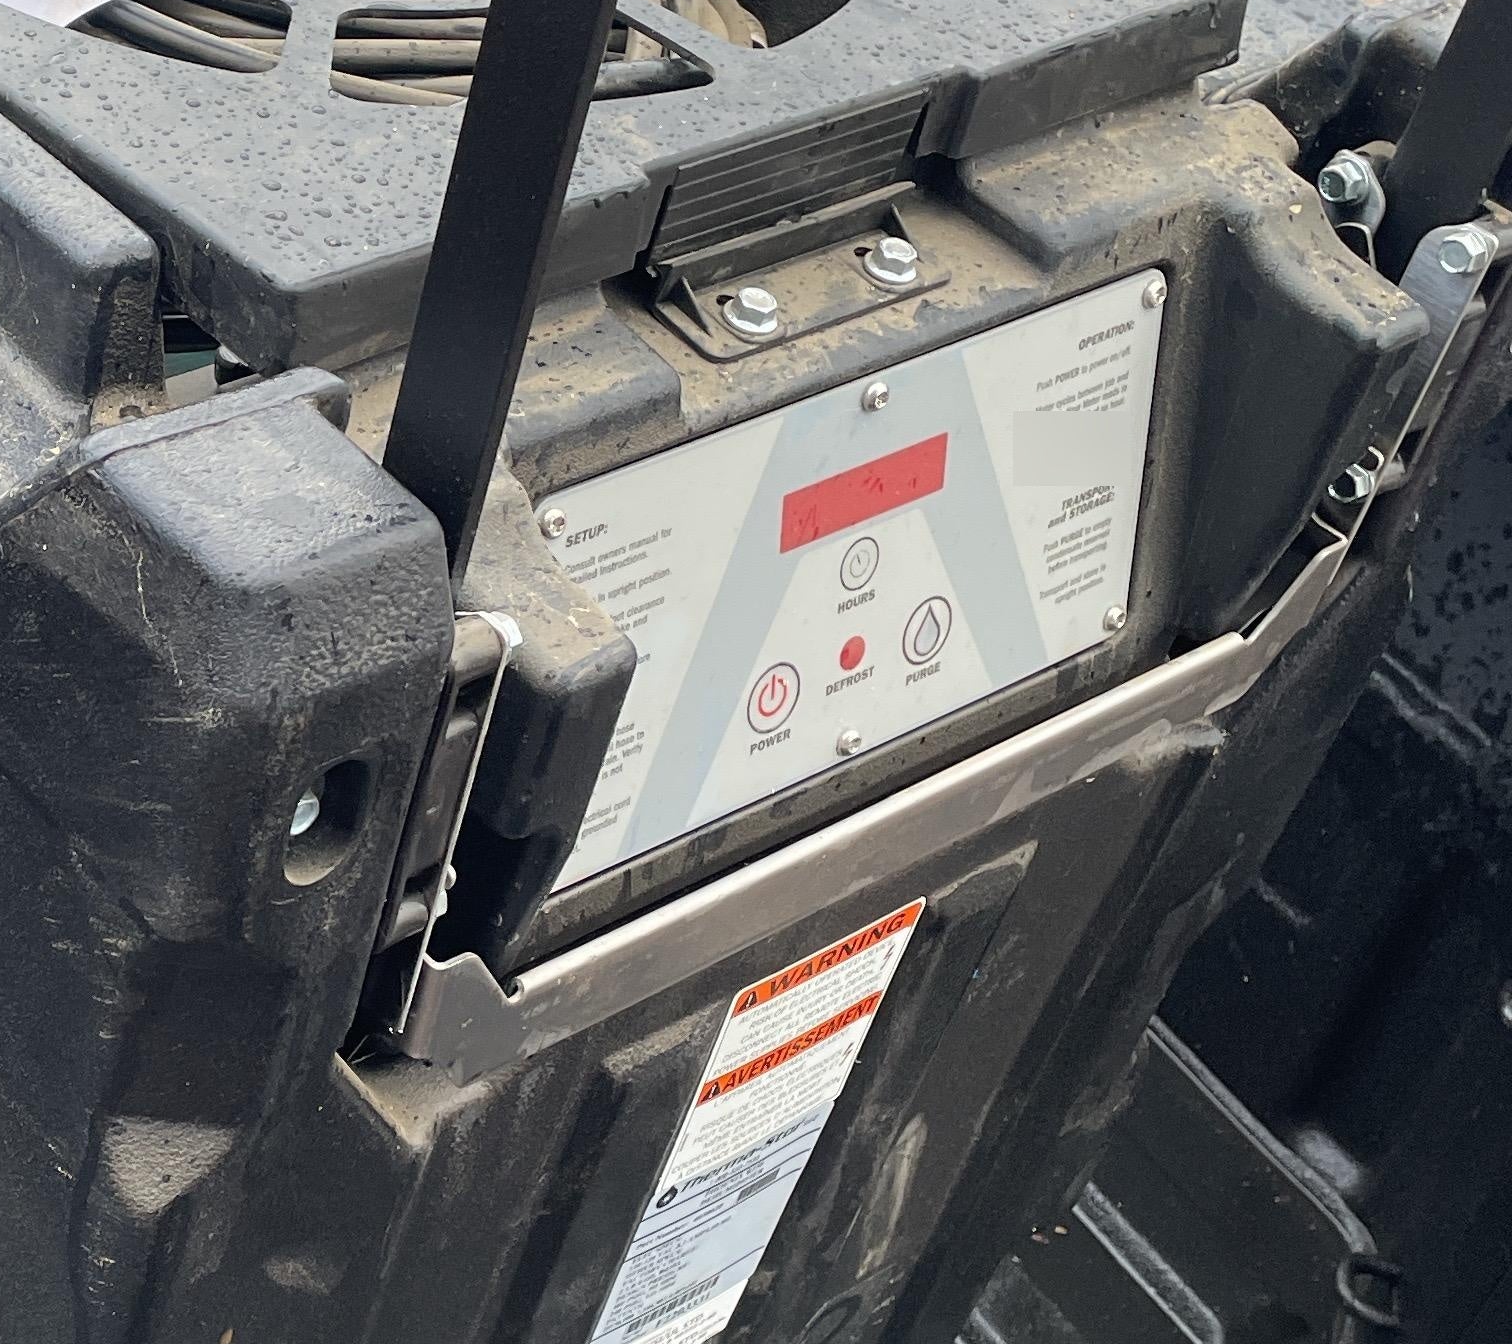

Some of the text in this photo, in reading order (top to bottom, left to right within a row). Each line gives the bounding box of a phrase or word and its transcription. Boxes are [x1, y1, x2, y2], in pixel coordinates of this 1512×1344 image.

[1078, 320, 1135, 351] OPERATION:
[1062, 486, 1115, 511] TRANSPO
[1069, 492, 1115, 520] STORAGE:
[565, 524, 609, 548] SETUP:
[838, 589, 876, 614] HOURS
[825, 665, 875, 696] DEFROST
[905, 661, 942, 686] PURGE
[750, 728, 792, 756] POWER
[770, 913, 906, 997] WARNING
[722, 996, 879, 1093] AVERTISSEMENT
